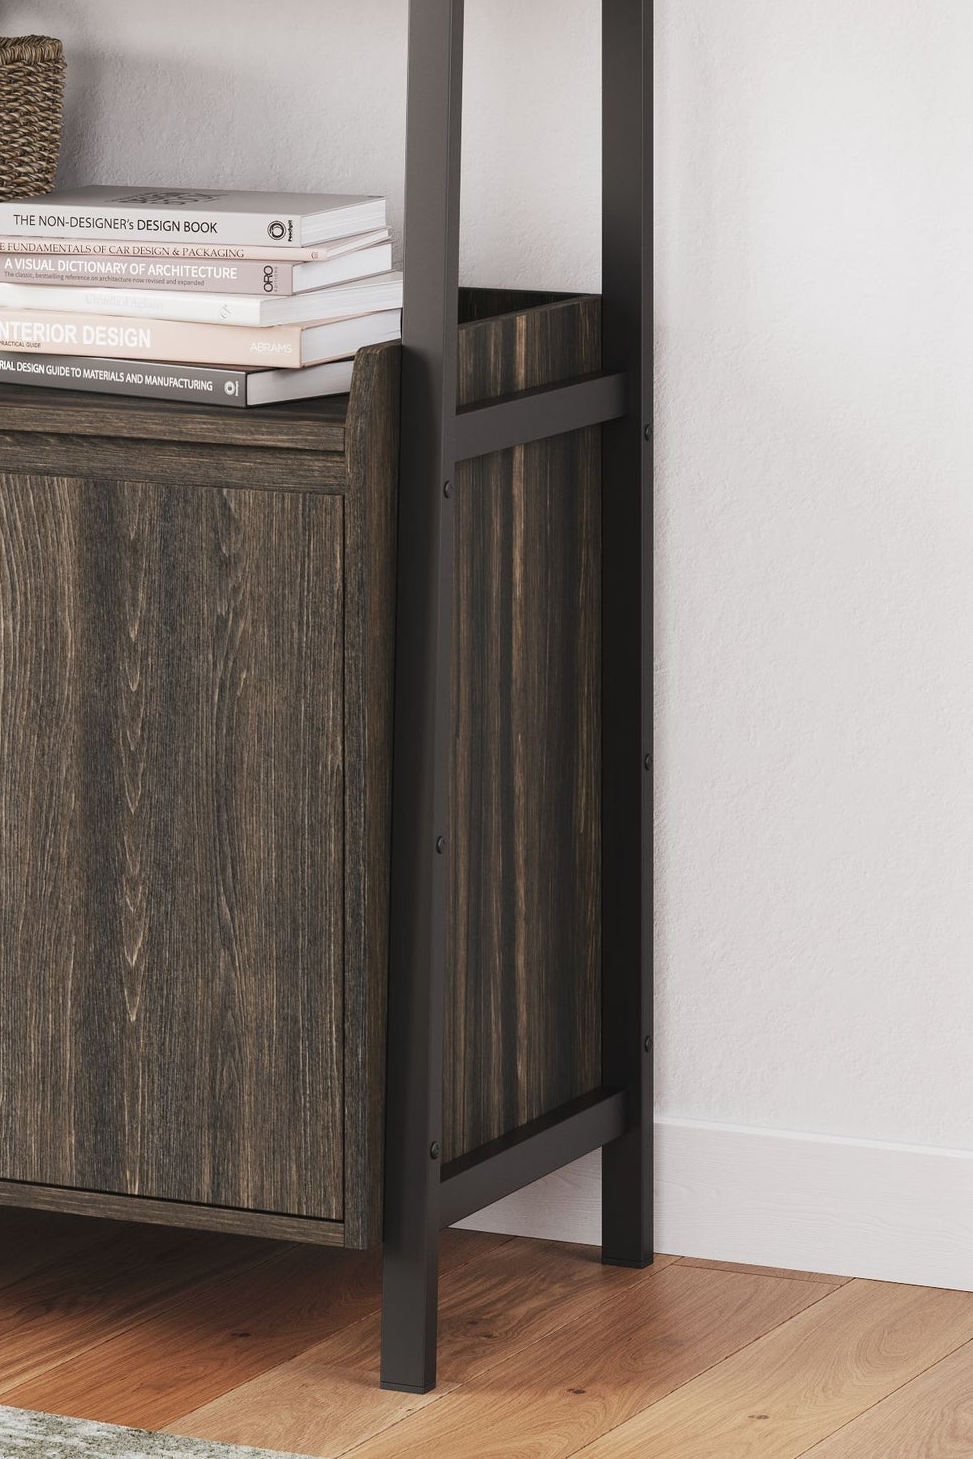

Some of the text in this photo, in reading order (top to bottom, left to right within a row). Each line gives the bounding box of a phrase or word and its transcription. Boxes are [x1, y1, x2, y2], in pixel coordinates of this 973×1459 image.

[13, 214, 218, 233] THE NON-DESIGNER's DESIGN BOOK
[7, 242, 92, 254] FUNDAMENTALS
[93, 244, 107, 254] OF
[108, 245, 130, 255] CAR
[132, 246, 170, 256] DESIGN
[172, 247, 180, 256] &
[182, 248, 245, 258] PACKAGING
[4, 258, 238, 279] A VISUAL DICTIONARY OF ARCHITECTURE
[35, 272, 64, 281] bestselling
[65, 273, 90, 281] reference
[99, 275, 132, 283] architecture
[82, 325, 152, 348] DESIGN
[250, 342, 292, 354] ABRAMS
[17, 361, 45, 375] DESIGN
[46, 365, 70, 377] GUIDE
[70, 367, 82, 378] TO
[82, 369, 125, 383] MATERIALS
[126, 373, 144, 384] AND
[144, 375, 213, 391] MANUFACTURING
